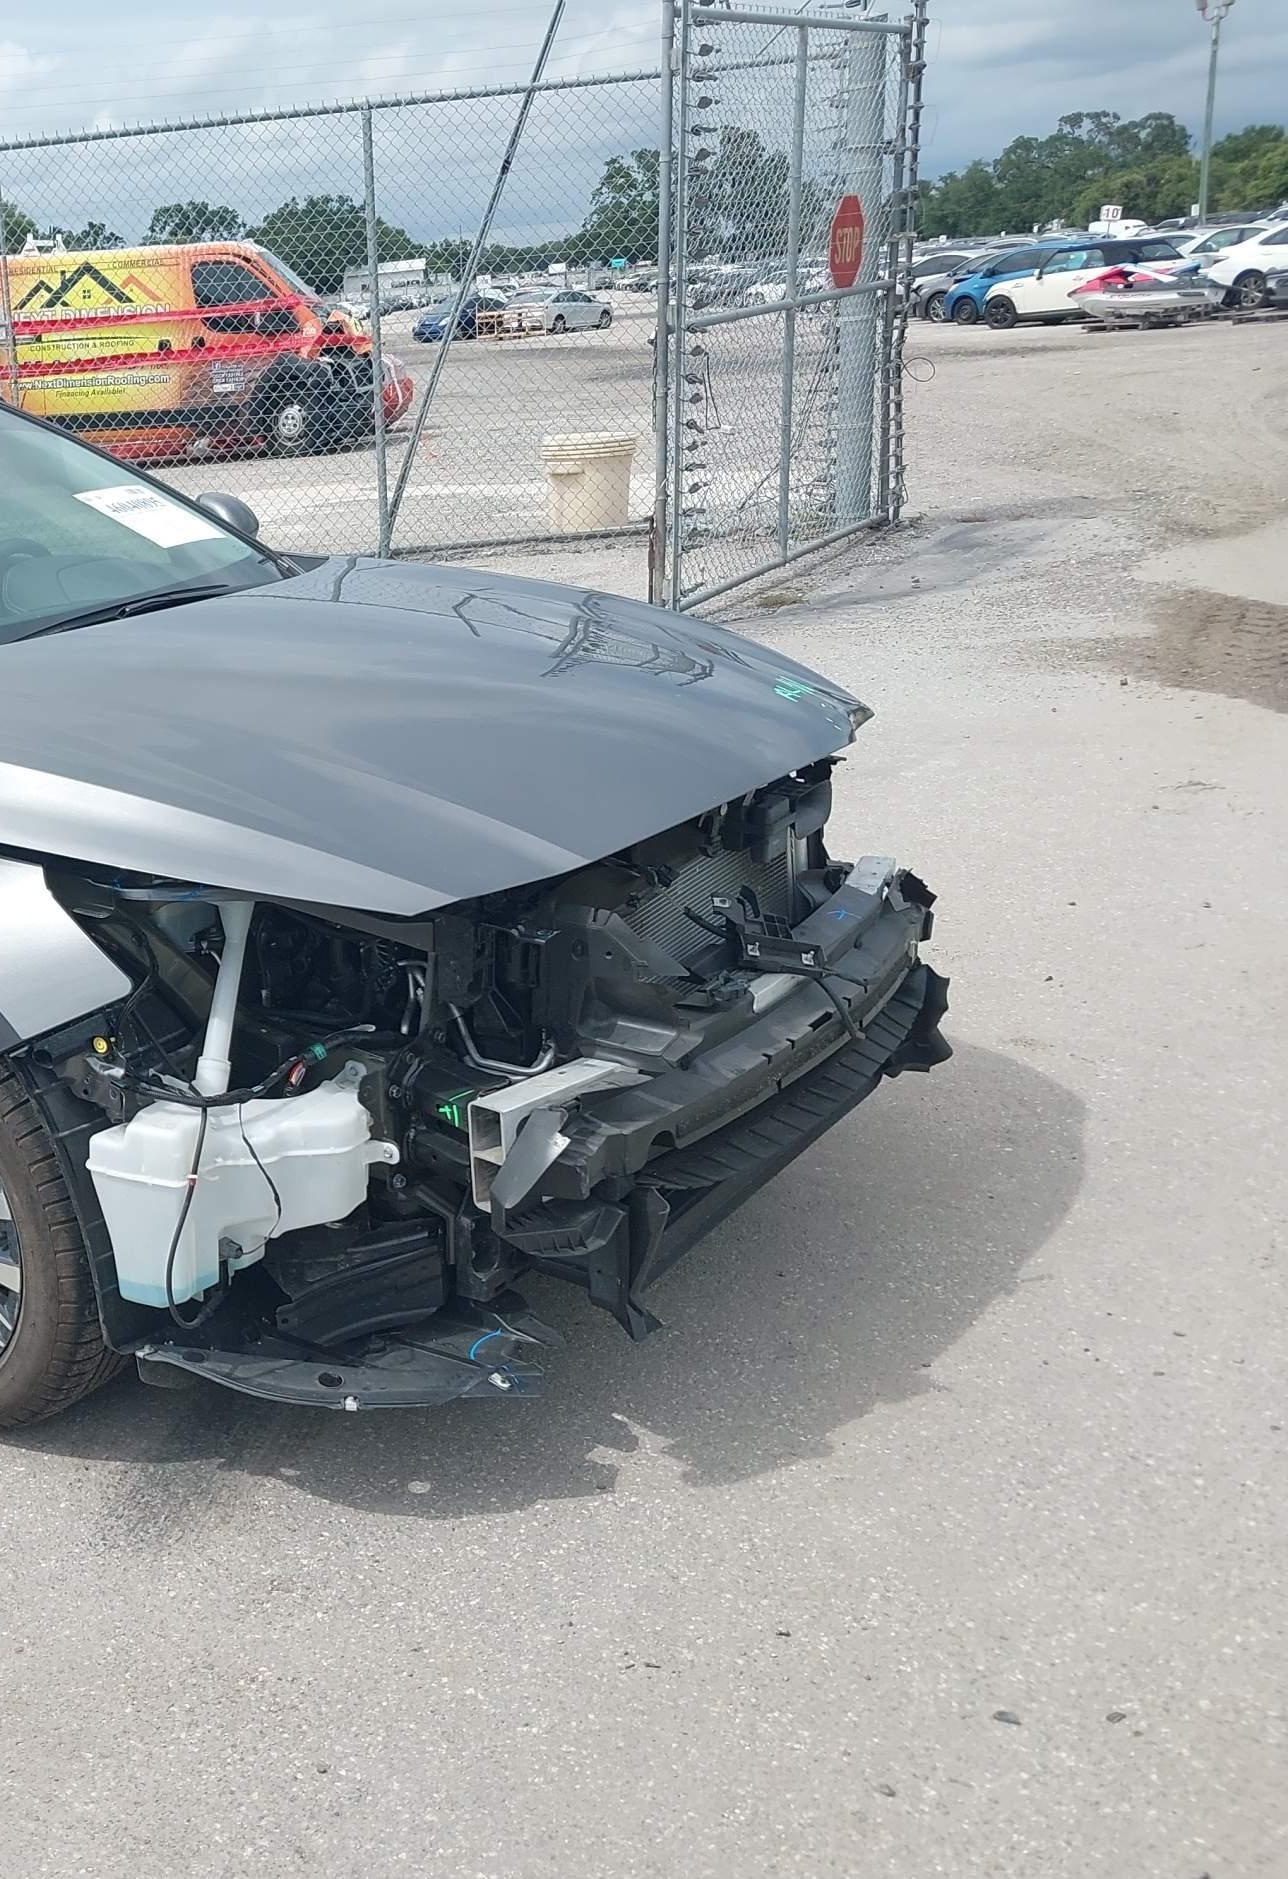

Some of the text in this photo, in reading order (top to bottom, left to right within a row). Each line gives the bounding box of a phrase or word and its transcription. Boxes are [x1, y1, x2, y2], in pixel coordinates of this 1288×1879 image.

[1104, 207, 1120, 219] 10
[834, 226, 861, 265] STOP
[112, 258, 162, 269] COMMERCIAL
[30, 342, 90, 352] CONSTRUCTION
[99, 339, 135, 348] ROOFING
